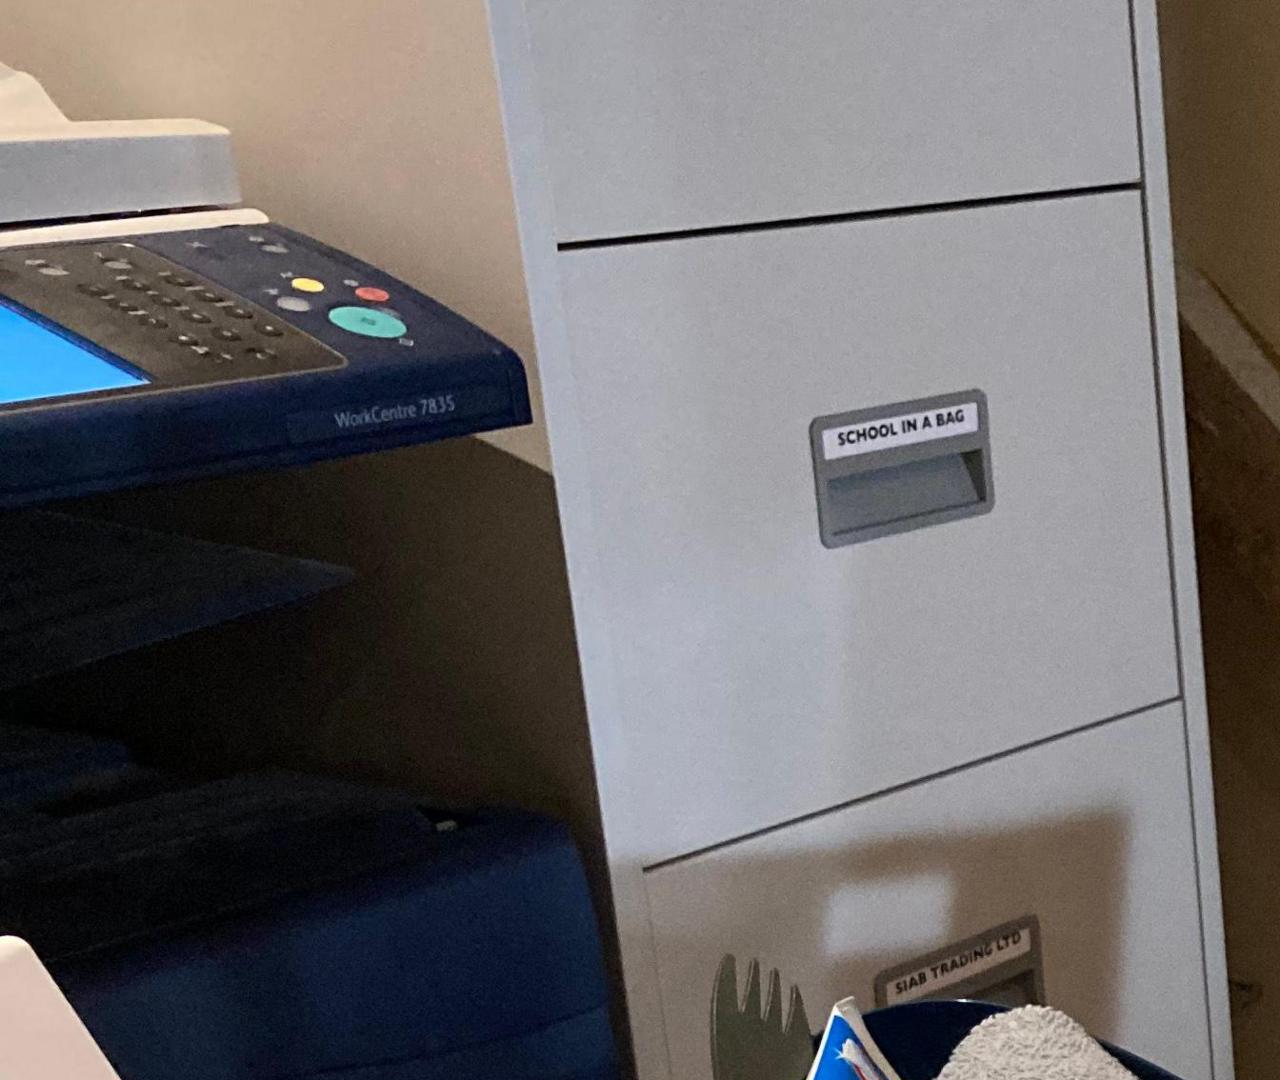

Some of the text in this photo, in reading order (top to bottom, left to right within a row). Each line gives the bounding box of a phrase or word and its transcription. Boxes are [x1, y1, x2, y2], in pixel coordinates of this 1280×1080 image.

[334, 394, 455, 427] WorkCentre 7835
[838, 409, 965, 446] SCHOOL IN A BAG
[896, 931, 1022, 994] SIAB TRADING LTD
